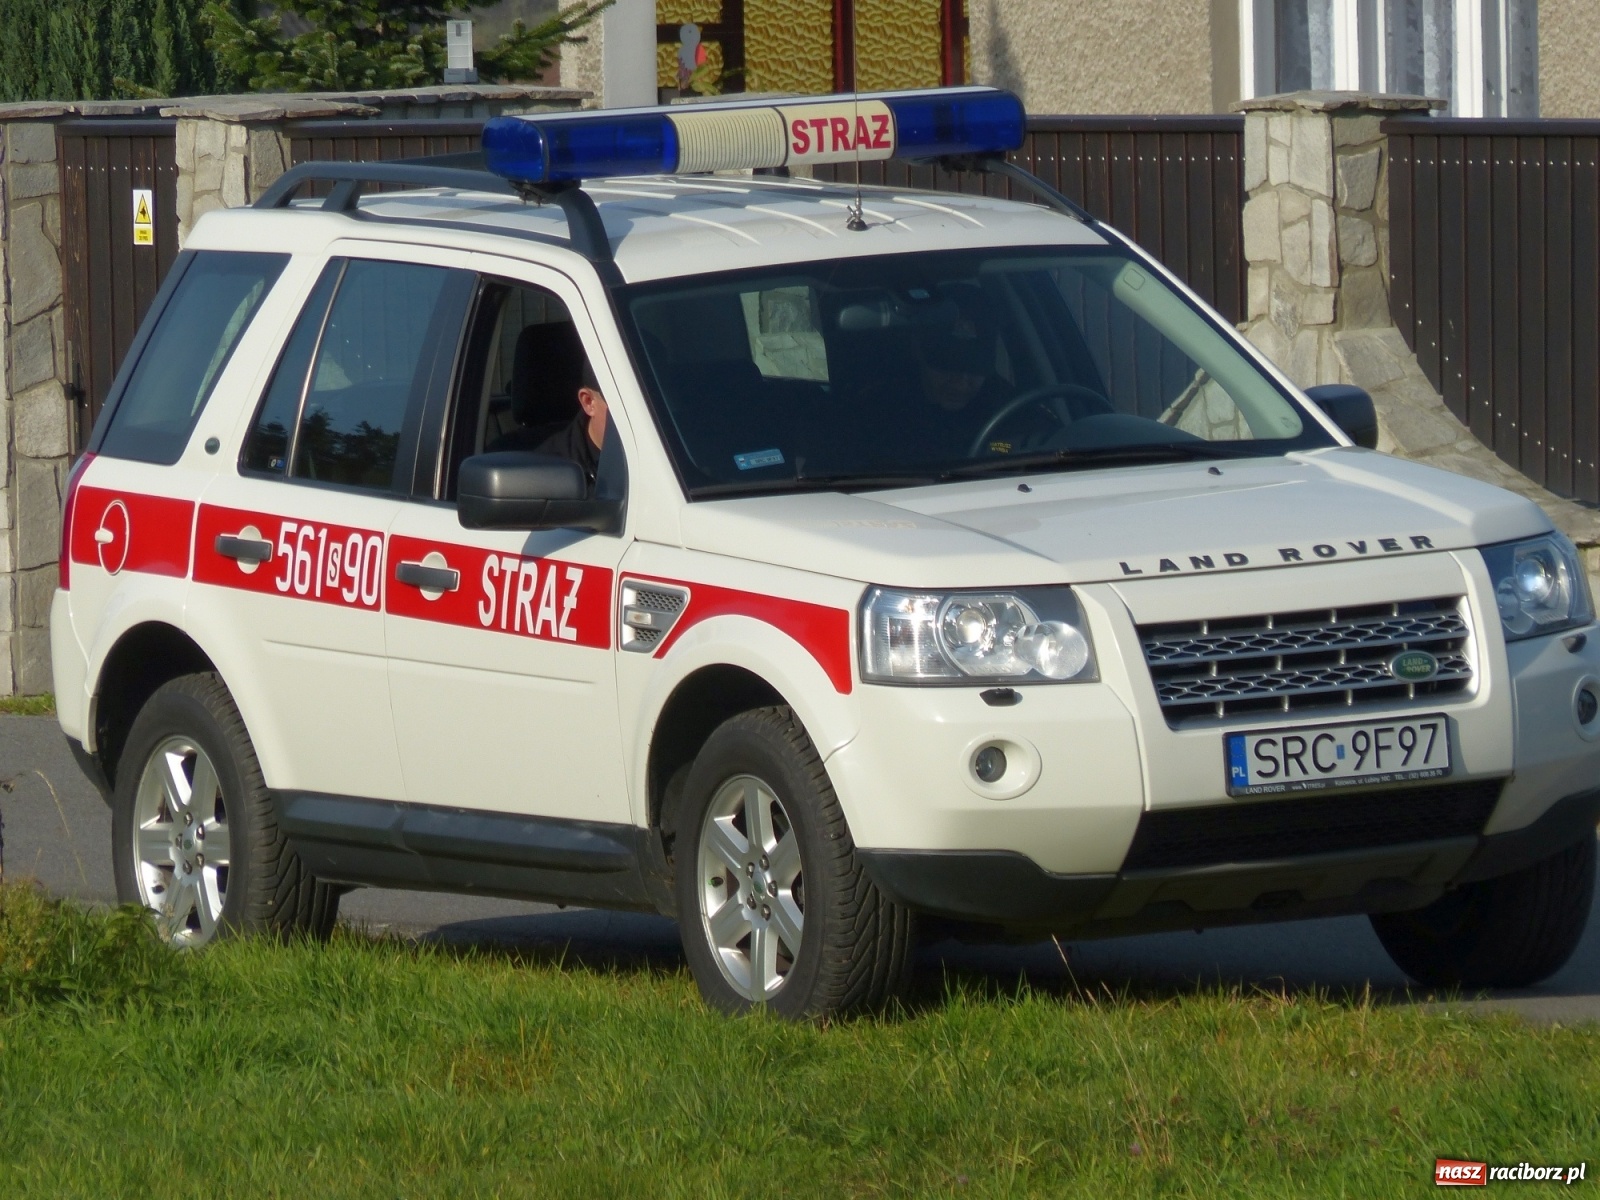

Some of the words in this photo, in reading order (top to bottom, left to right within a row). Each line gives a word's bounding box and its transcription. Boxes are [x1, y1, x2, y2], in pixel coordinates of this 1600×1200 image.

[1119, 552, 1249, 576] LAND
[1278, 535, 1435, 563] ROVER
[1253, 732, 1337, 778] SRC
[1351, 723, 1438, 771] 9F97
[1231, 767, 1246, 778] PL
[1245, 786, 1262, 794] LAND
[1263, 785, 1286, 793] ROVER
